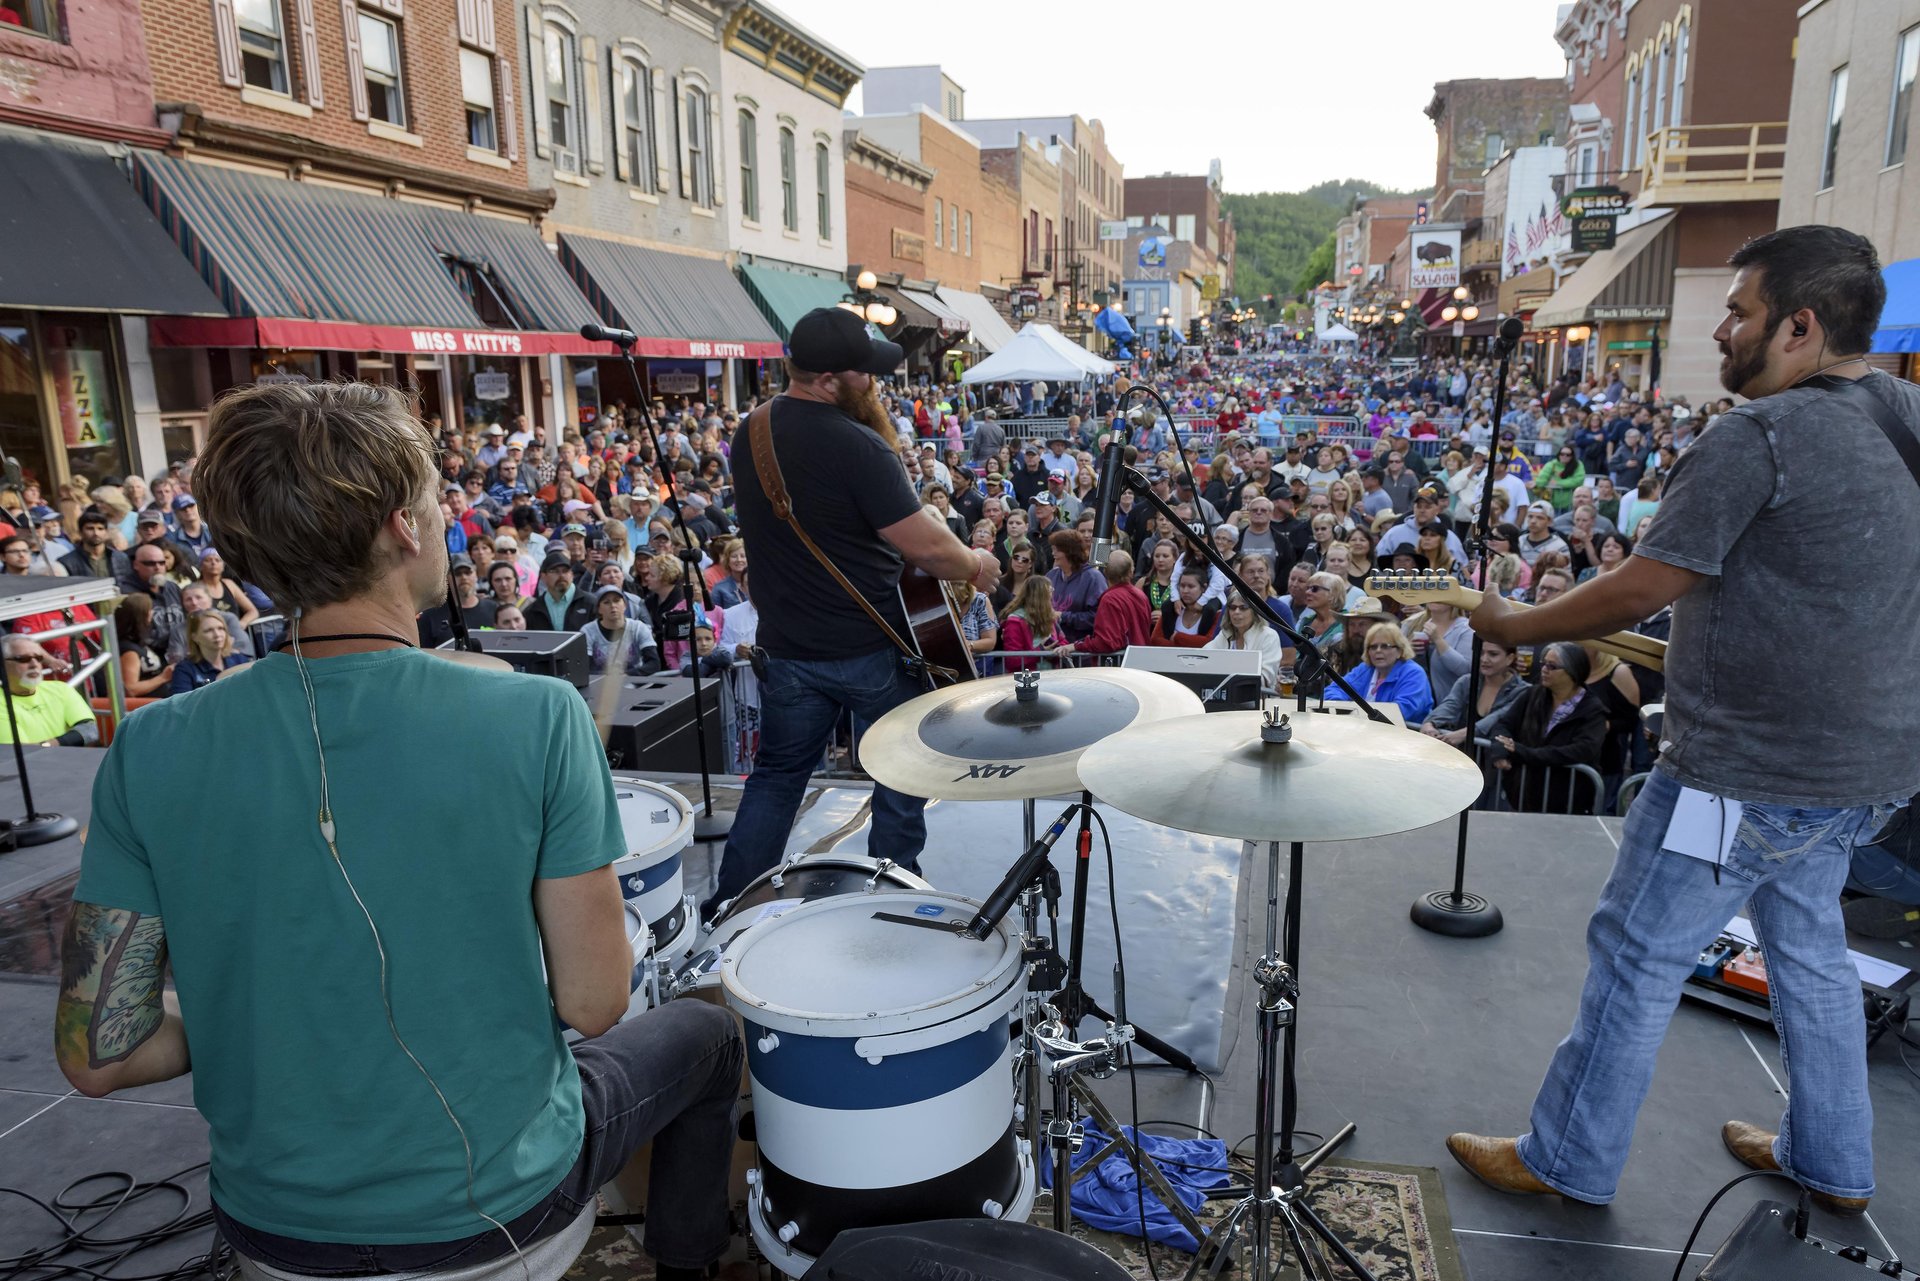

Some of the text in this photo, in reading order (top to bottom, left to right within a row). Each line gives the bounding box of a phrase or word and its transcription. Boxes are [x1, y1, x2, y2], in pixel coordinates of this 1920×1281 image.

[1570, 195, 1623, 208] BERG
[1413, 273, 1457, 286] SALOON
[1594, 307, 1666, 318] Black Hills Gold
[411, 331, 522, 353] MISS KITTY'S
[690, 342, 745, 357] MISS KITTY'S
[64, 328, 97, 441] PIZZA
[952, 764, 1026, 782] AAX
